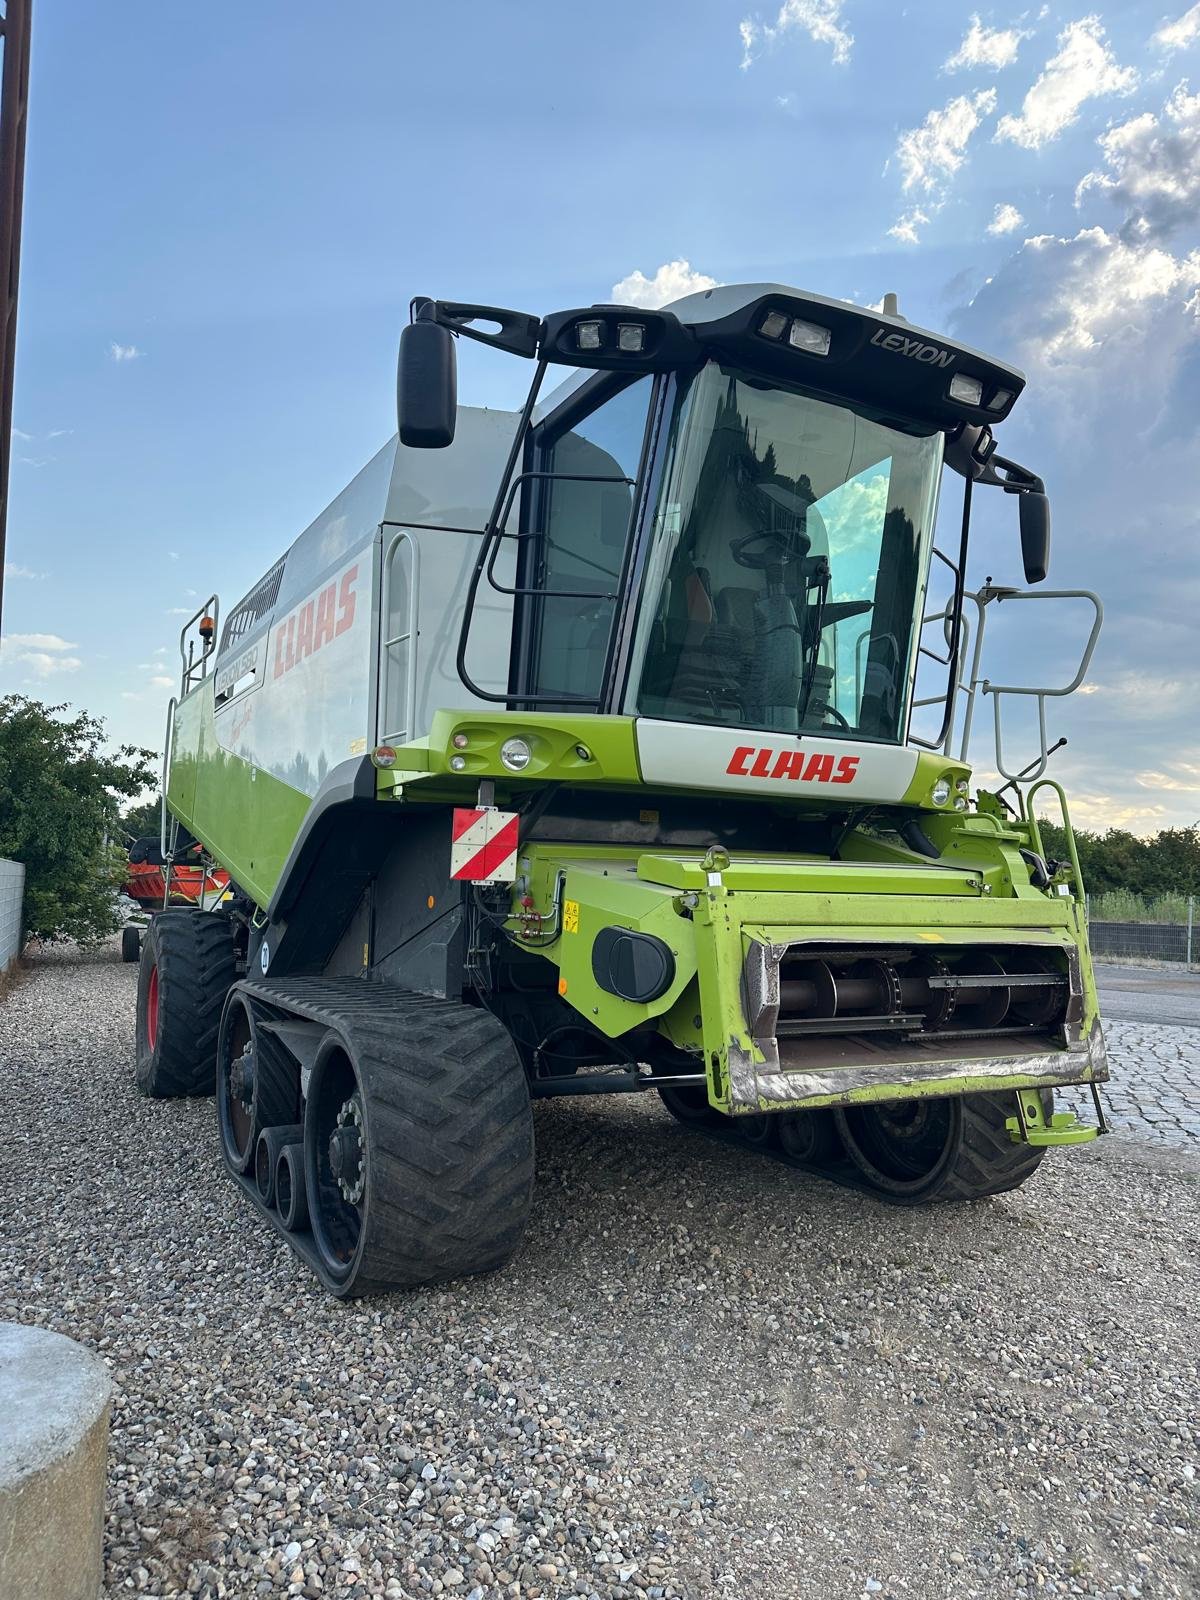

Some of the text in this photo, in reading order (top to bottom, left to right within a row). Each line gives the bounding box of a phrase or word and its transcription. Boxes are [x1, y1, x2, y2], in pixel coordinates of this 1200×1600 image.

[870, 328, 957, 368] LEXION
[273, 564, 359, 680] CLAAS
[726, 746, 861, 784] CLAAS
